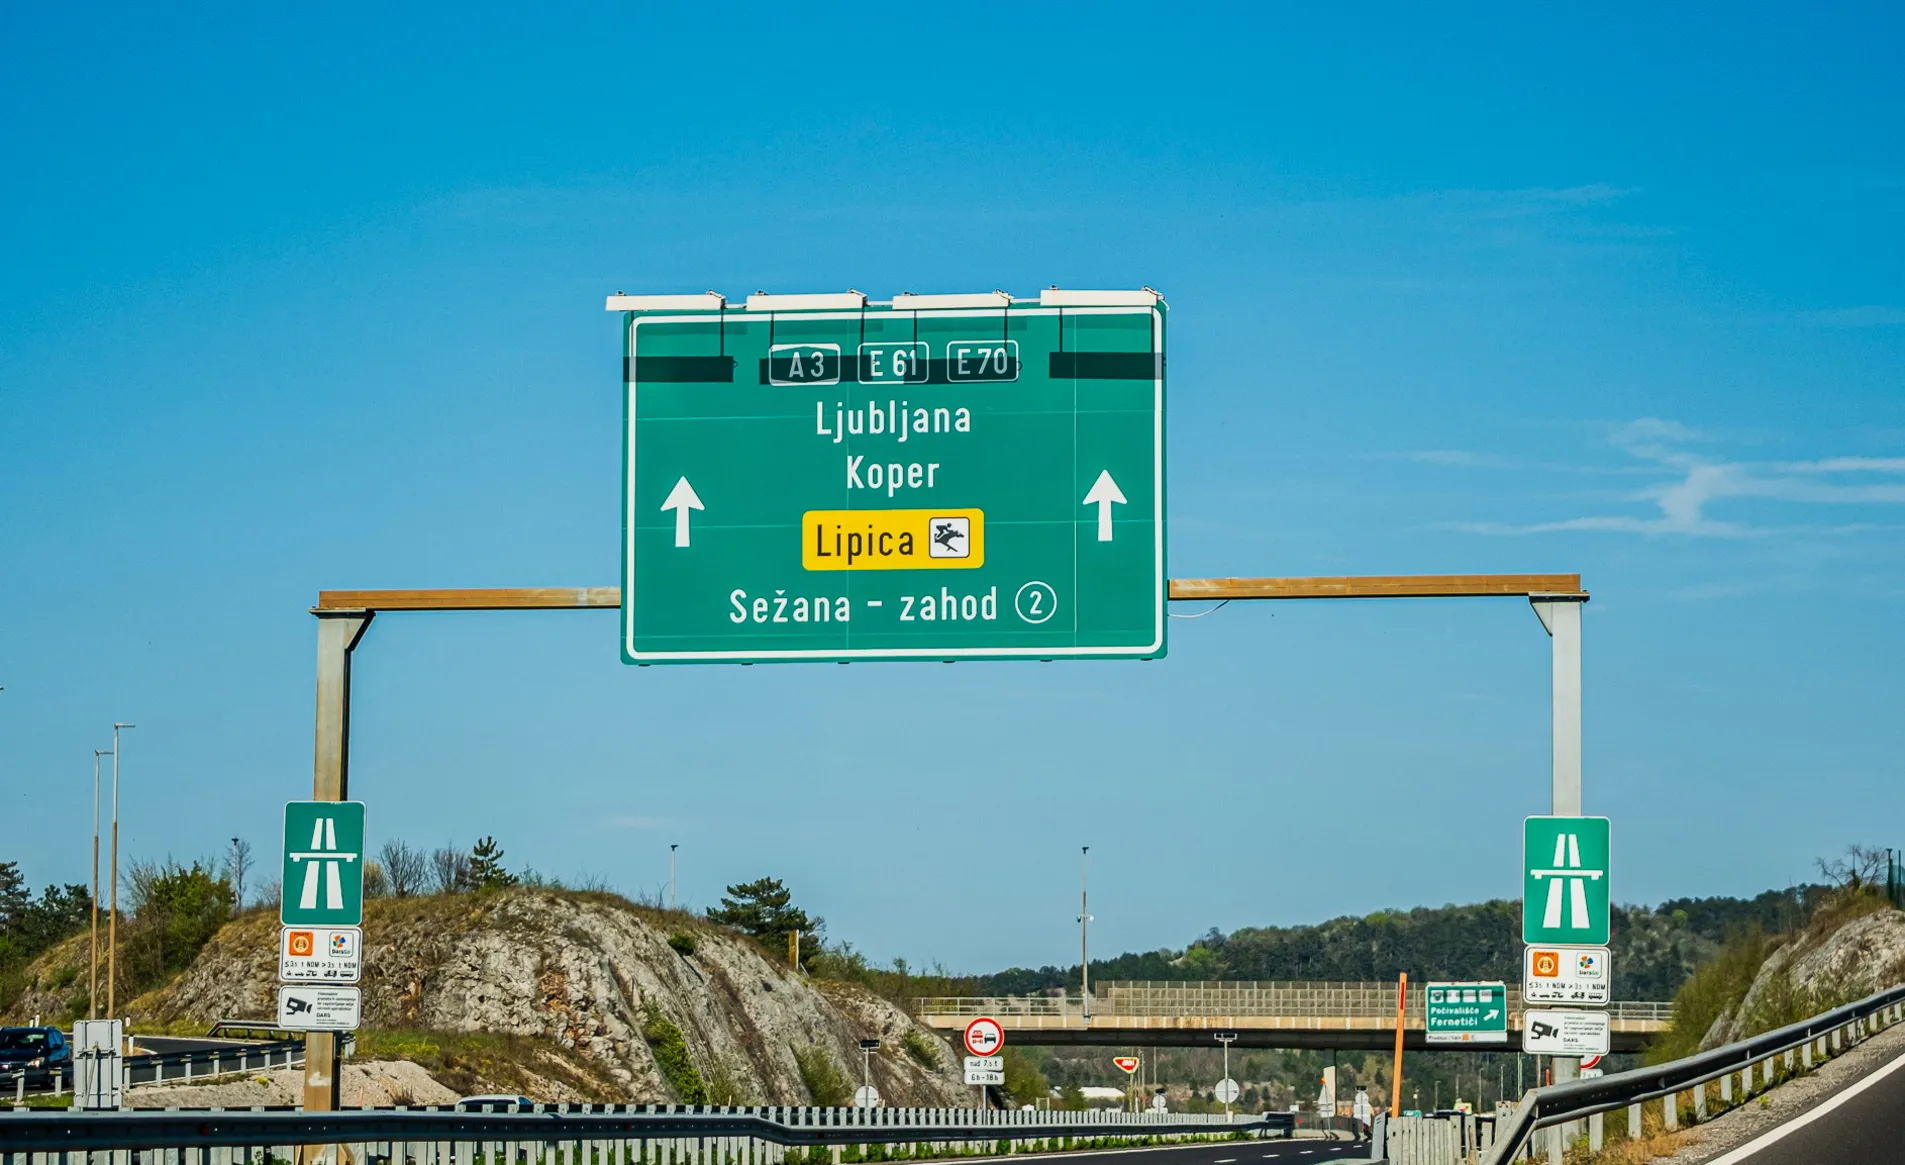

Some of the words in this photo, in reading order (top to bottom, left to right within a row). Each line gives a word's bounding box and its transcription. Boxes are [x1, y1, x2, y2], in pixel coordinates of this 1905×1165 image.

[816, 399, 971, 443] Ljubljana
[846, 455, 940, 498] Koper
[817, 524, 913, 566] Lipica
[730, 588, 850, 623] Sežana
[900, 586, 998, 622] zahod
[1030, 590, 1042, 614] 2
[1430, 1006, 1480, 1015] Počivališče
[1431, 1017, 1478, 1026] Fernetiči
